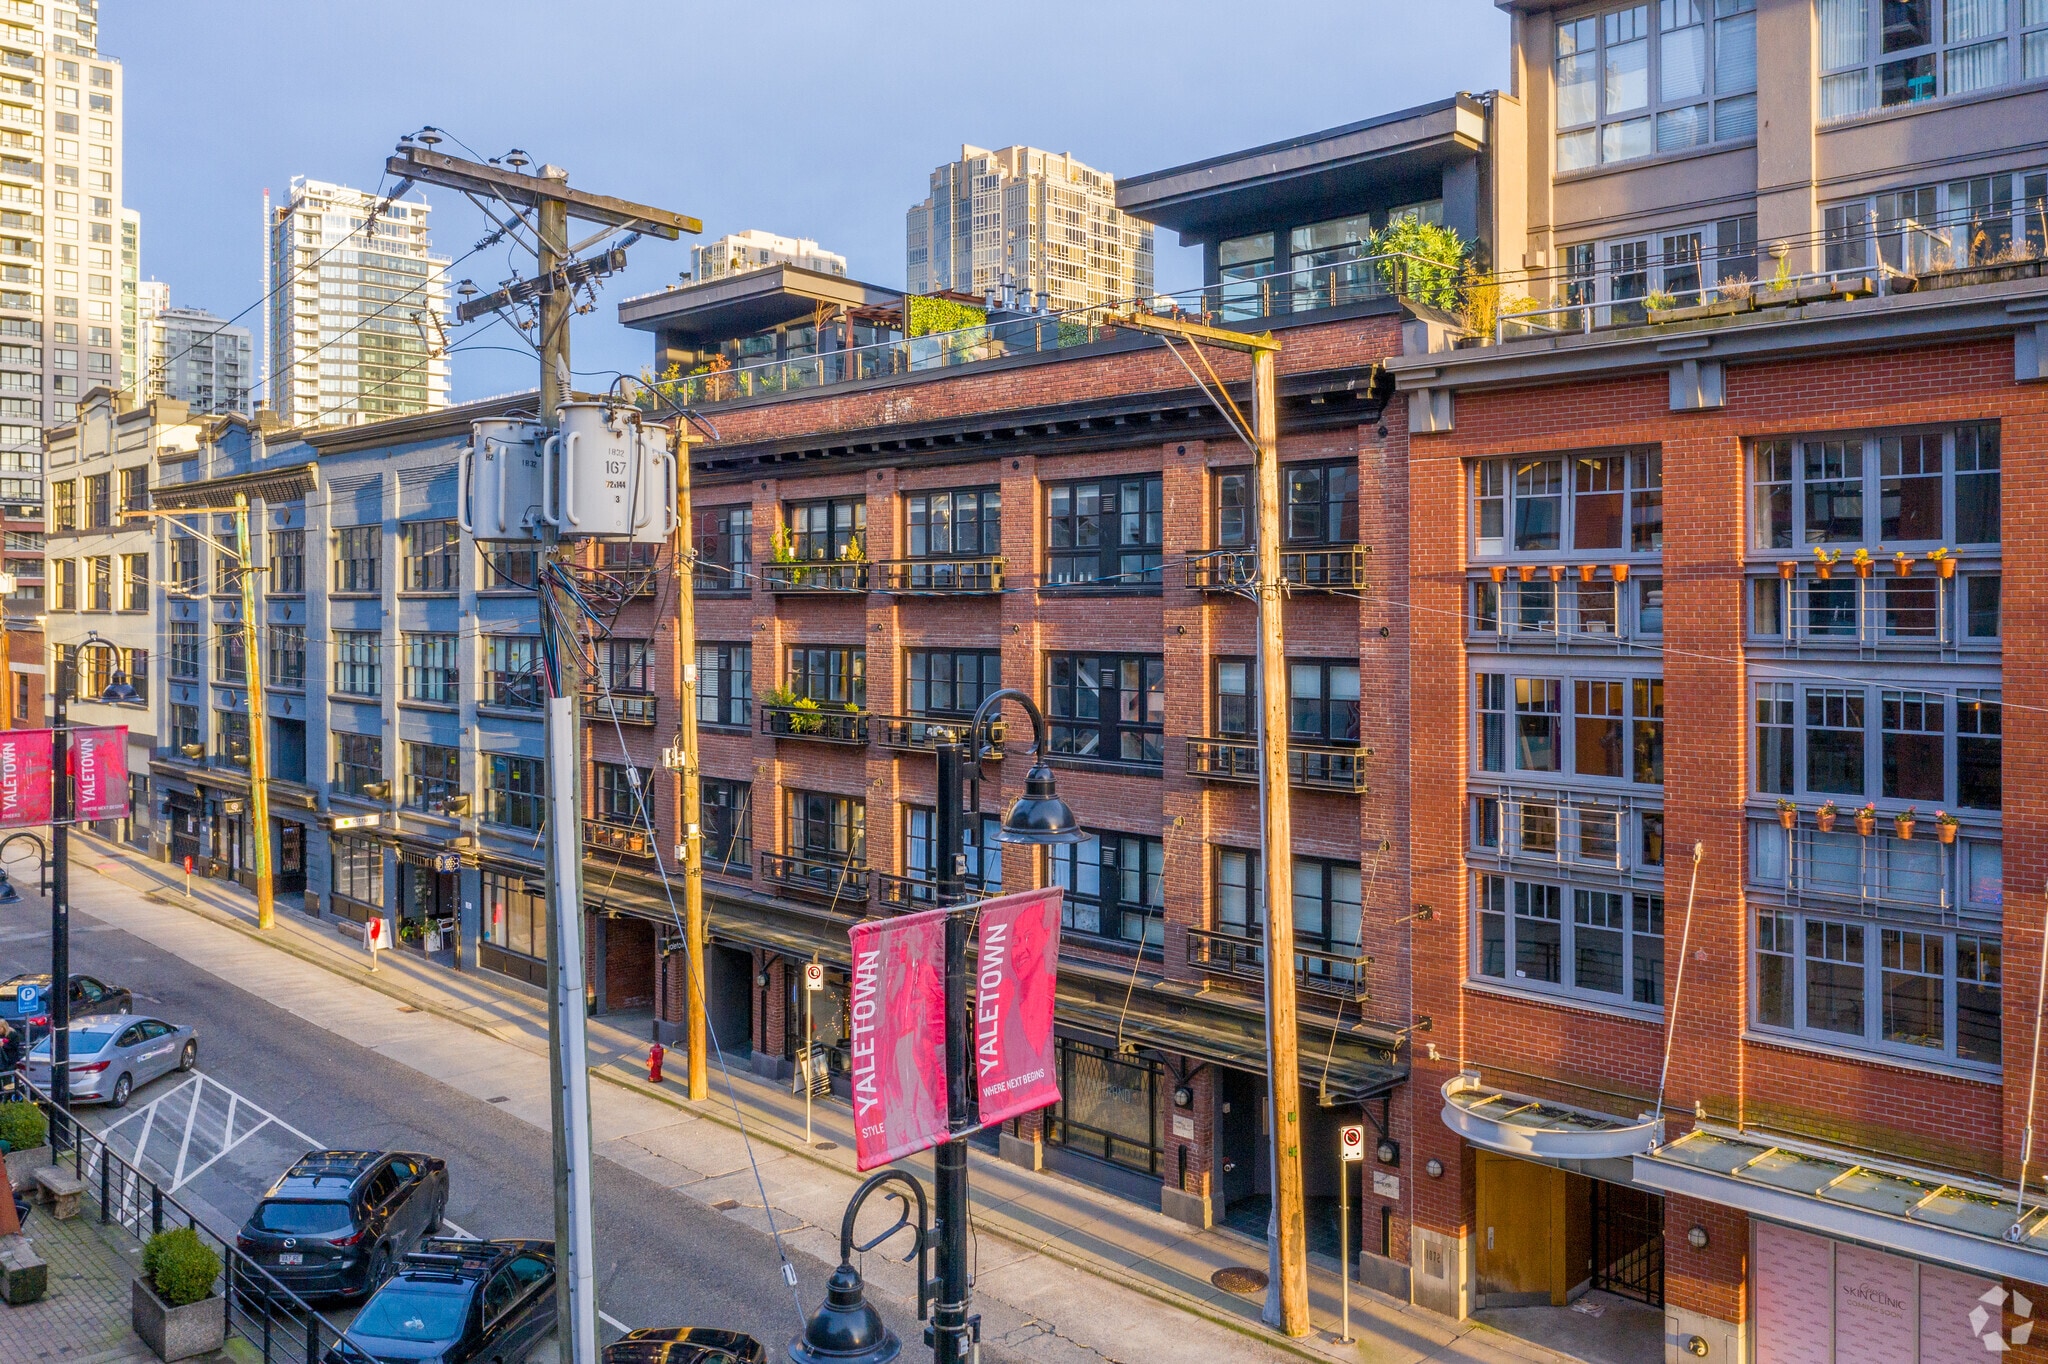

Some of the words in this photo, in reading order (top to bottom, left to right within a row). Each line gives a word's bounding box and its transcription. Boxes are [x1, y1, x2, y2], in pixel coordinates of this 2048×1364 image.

[605, 460, 627, 474] 167
[615, 495, 621, 503] 3
[2, 742, 17, 811] YALETOWN
[80, 738, 96, 804] YALETOWN
[978, 923, 1008, 1077] YALETOWN
[853, 949, 881, 1116] YALETOWN
[982, 1081, 1007, 1098] WHERE
[1007, 1076, 1023, 1090] NEXT
[1023, 1068, 1045, 1085] BEGINS
[861, 1122, 885, 1139] STYLE
[1843, 1285, 1868, 1300] SKIN
[1869, 1291, 1907, 1311] CLINIC
[1846, 1299, 1879, 1313] COMING
[1880, 1308, 1903, 1320] SOON
